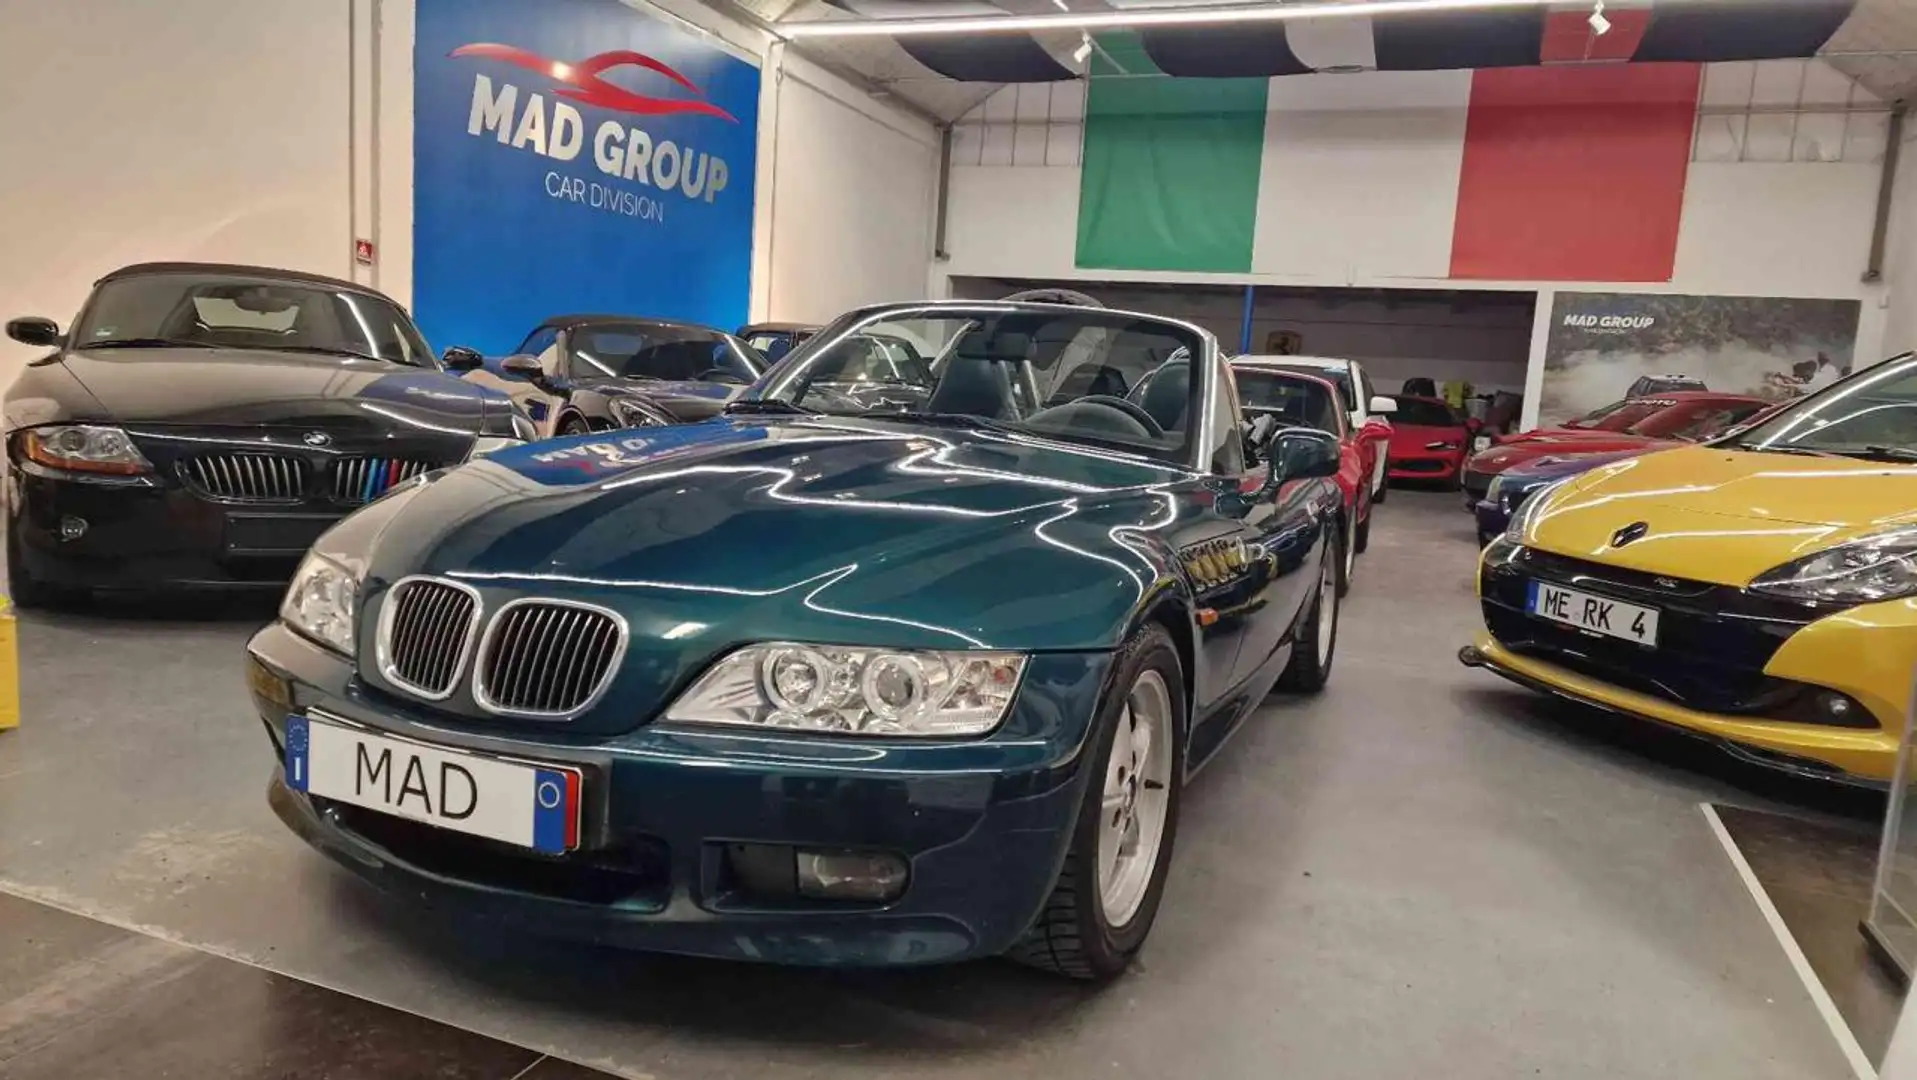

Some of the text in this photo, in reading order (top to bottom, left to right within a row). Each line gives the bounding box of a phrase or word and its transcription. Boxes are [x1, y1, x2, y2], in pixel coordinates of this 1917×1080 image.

[468, 73, 728, 203] MAD GROUP
[545, 172, 664, 222] CAR DIVISION
[1563, 313, 1655, 329] MAD GROUP
[1544, 588, 1646, 639] ME RK 4
[356, 742, 478, 820] MAD
